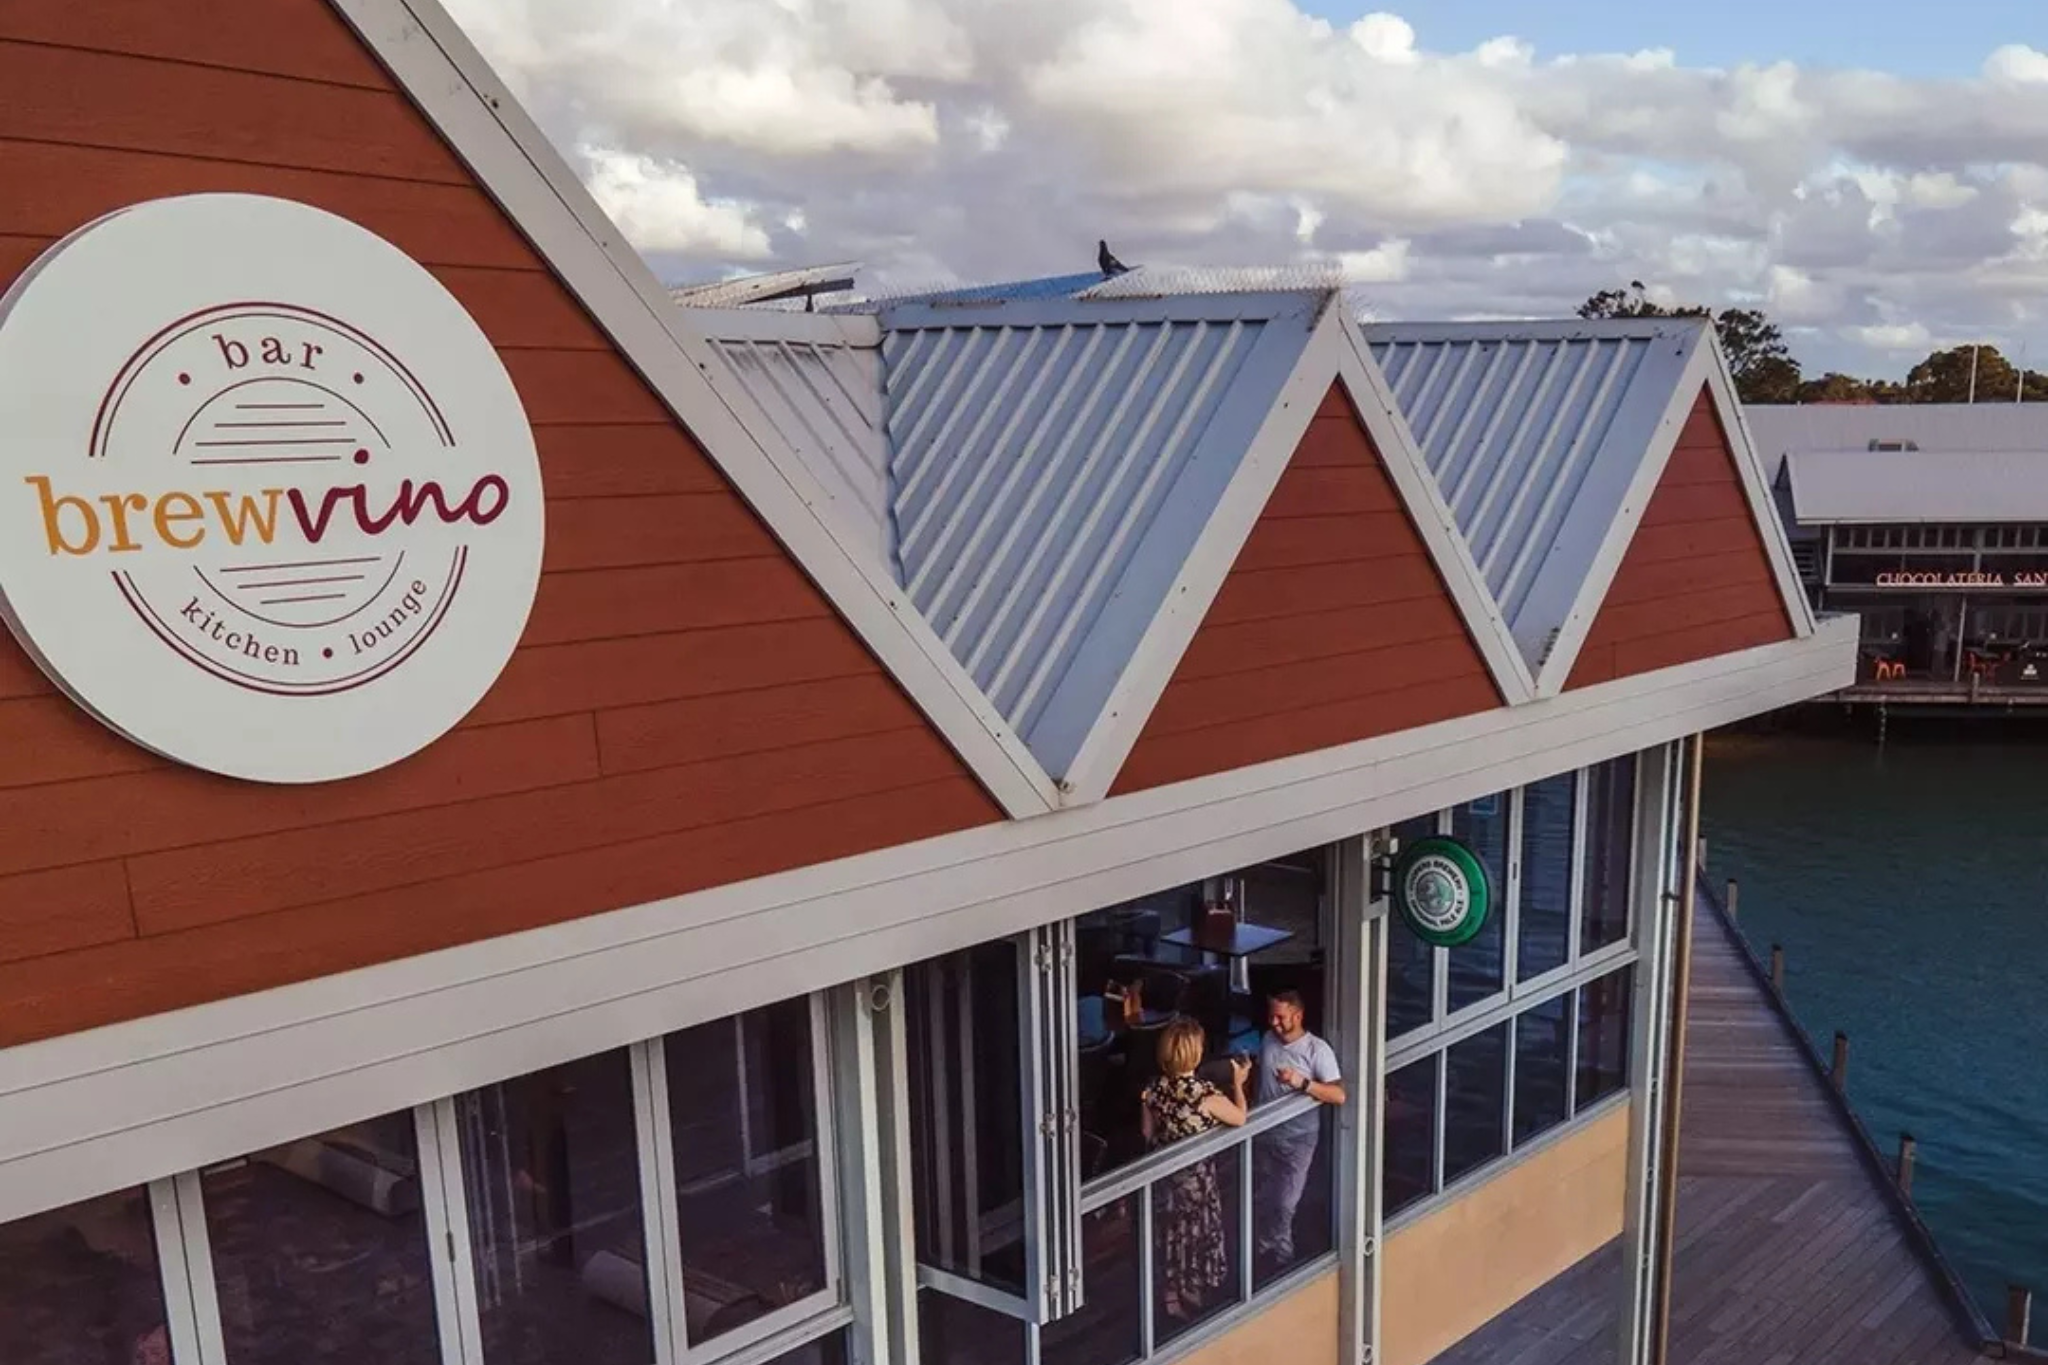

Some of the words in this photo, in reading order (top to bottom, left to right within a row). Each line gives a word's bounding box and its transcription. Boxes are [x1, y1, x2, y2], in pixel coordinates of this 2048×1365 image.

[212, 333, 324, 370] bar
[25, 448, 510, 556] brewvino
[1876, 572, 2004, 587] CHOCOLATERIA
[2013, 572, 2048, 587] SAN
[179, 596, 301, 667] kitchen
[348, 576, 429, 656] lounge
